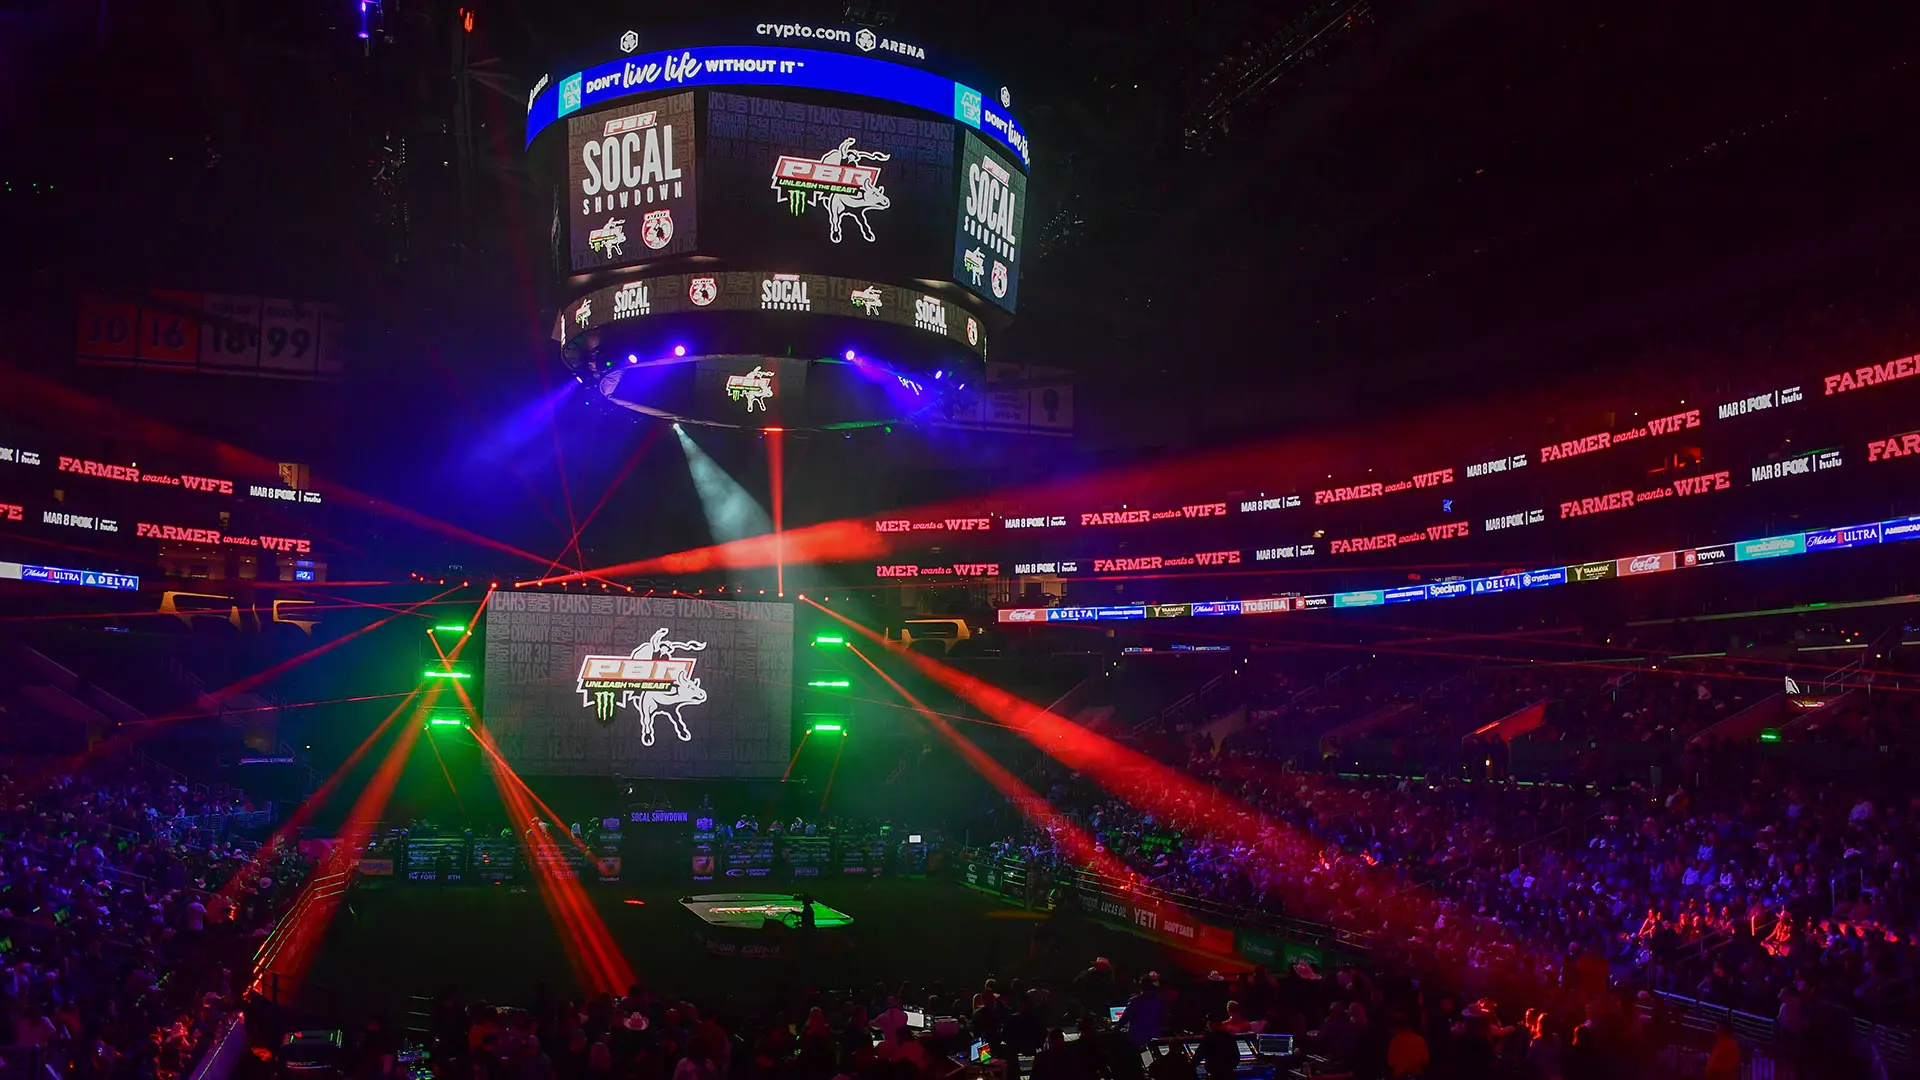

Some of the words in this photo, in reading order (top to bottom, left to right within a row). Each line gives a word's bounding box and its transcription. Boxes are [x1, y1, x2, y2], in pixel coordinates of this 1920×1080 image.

[756, 21, 850, 43] crypto.com
[880, 38, 925, 60] ARENA
[586, 73, 621, 94] DON'T
[623, 62, 662, 88] live
[664, 52, 702, 83] life
[705, 59, 777, 73] WITHOUT
[607, 114, 655, 134] PBR
[582, 124, 682, 195] SOCAL
[783, 161, 872, 185] PBR
[779, 178, 818, 189] UNLEASH
[829, 186, 858, 195] BEAST
[582, 181, 682, 216] SHOWDOWN
[966, 162, 1016, 245] SOCAL
[614, 286, 650, 313] SOCAL
[762, 280, 810, 303] SOCAL
[915, 299, 947, 328] SOCAL
[150, 316, 183, 350] 16
[266, 326, 311, 358] 99
[1719, 402, 1738, 419] MAR
[1740, 400, 1746, 414] 8
[1747, 393, 1772, 412] FOX
[1781, 392, 1803, 405] hulu
[1540, 432, 1611, 463] FARMER
[1613, 427, 1639, 444] wants
[1647, 409, 1701, 437] WIFE
[1868, 434, 1920, 462] FAR
[1466, 464, 1481, 478] MAR
[1482, 463, 1487, 475] 8
[1751, 464, 1773, 482] MAR
[1774, 462, 1781, 478] 8
[1782, 457, 1809, 476] FOX
[1819, 457, 1842, 470] hulu
[59, 456, 140, 483] FARMER
[142, 473, 171, 485] wants
[182, 475, 234, 495] WIFE
[250, 485, 267, 499] MAR
[268, 487, 274, 499] 8
[1315, 482, 1383, 505] FARMER
[1384, 482, 1406, 494] wants
[1412, 468, 1454, 489] WIFE
[1560, 490, 1634, 519] FARMER
[1636, 487, 1663, 503] wants
[1673, 470, 1730, 499] WIFE
[1080, 509, 1150, 525] FARMER
[1152, 510, 1173, 519] wants
[1182, 503, 1226, 517] WIFE
[1241, 501, 1256, 512] MAR
[1257, 500, 1262, 511] 8
[43, 511, 62, 525] MAR
[63, 513, 69, 526] 8
[876, 520, 910, 532] MER
[912, 522, 936, 530] wants
[945, 518, 990, 531] WIFE
[1005, 518, 1020, 529] MAR
[1021, 518, 1026, 528] 8
[1485, 518, 1499, 532] MAR
[1500, 517, 1505, 530] 8
[136, 522, 220, 545] FARMER
[222, 535, 250, 546] wants
[260, 536, 310, 553] WIFE
[1330, 533, 1397, 554] FARMER
[1398, 532, 1419, 544] wants
[1426, 521, 1469, 541] WIFE
[1844, 529, 1877, 542] ULTRA
[1093, 556, 1162, 572] FARMER
[1164, 558, 1186, 567] wants
[1195, 550, 1240, 566] WIFE
[1256, 549, 1270, 561] MAR
[1271, 548, 1277, 560] 8
[1697, 550, 1725, 561] TOYOTA
[53, 570, 79, 581] ULTRA
[920, 567, 944, 575] wants
[953, 564, 999, 576] WIFE
[1015, 564, 1029, 574] MAR
[1030, 563, 1036, 574] 8
[98, 575, 135, 587] DELTA
[1486, 577, 1516, 589] DELTA
[1531, 571, 1561, 583] crypto.com
[1430, 584, 1464, 596] Spectrum
[1218, 603, 1240, 611] ULTRA
[1244, 598, 1286, 610] TOSHIBA
[1306, 597, 1327, 605] TOYOTA
[1061, 609, 1093, 618] DELTA
[588, 660, 686, 680] PBR
[585, 680, 628, 689] UNLEASH
[641, 682, 670, 690] BEAST
[631, 812, 650, 822] SOCAL
[652, 812, 688, 822] SHOWDOWN
[1101, 902, 1118, 915] LUCAS
[1133, 907, 1157, 930] YETI
